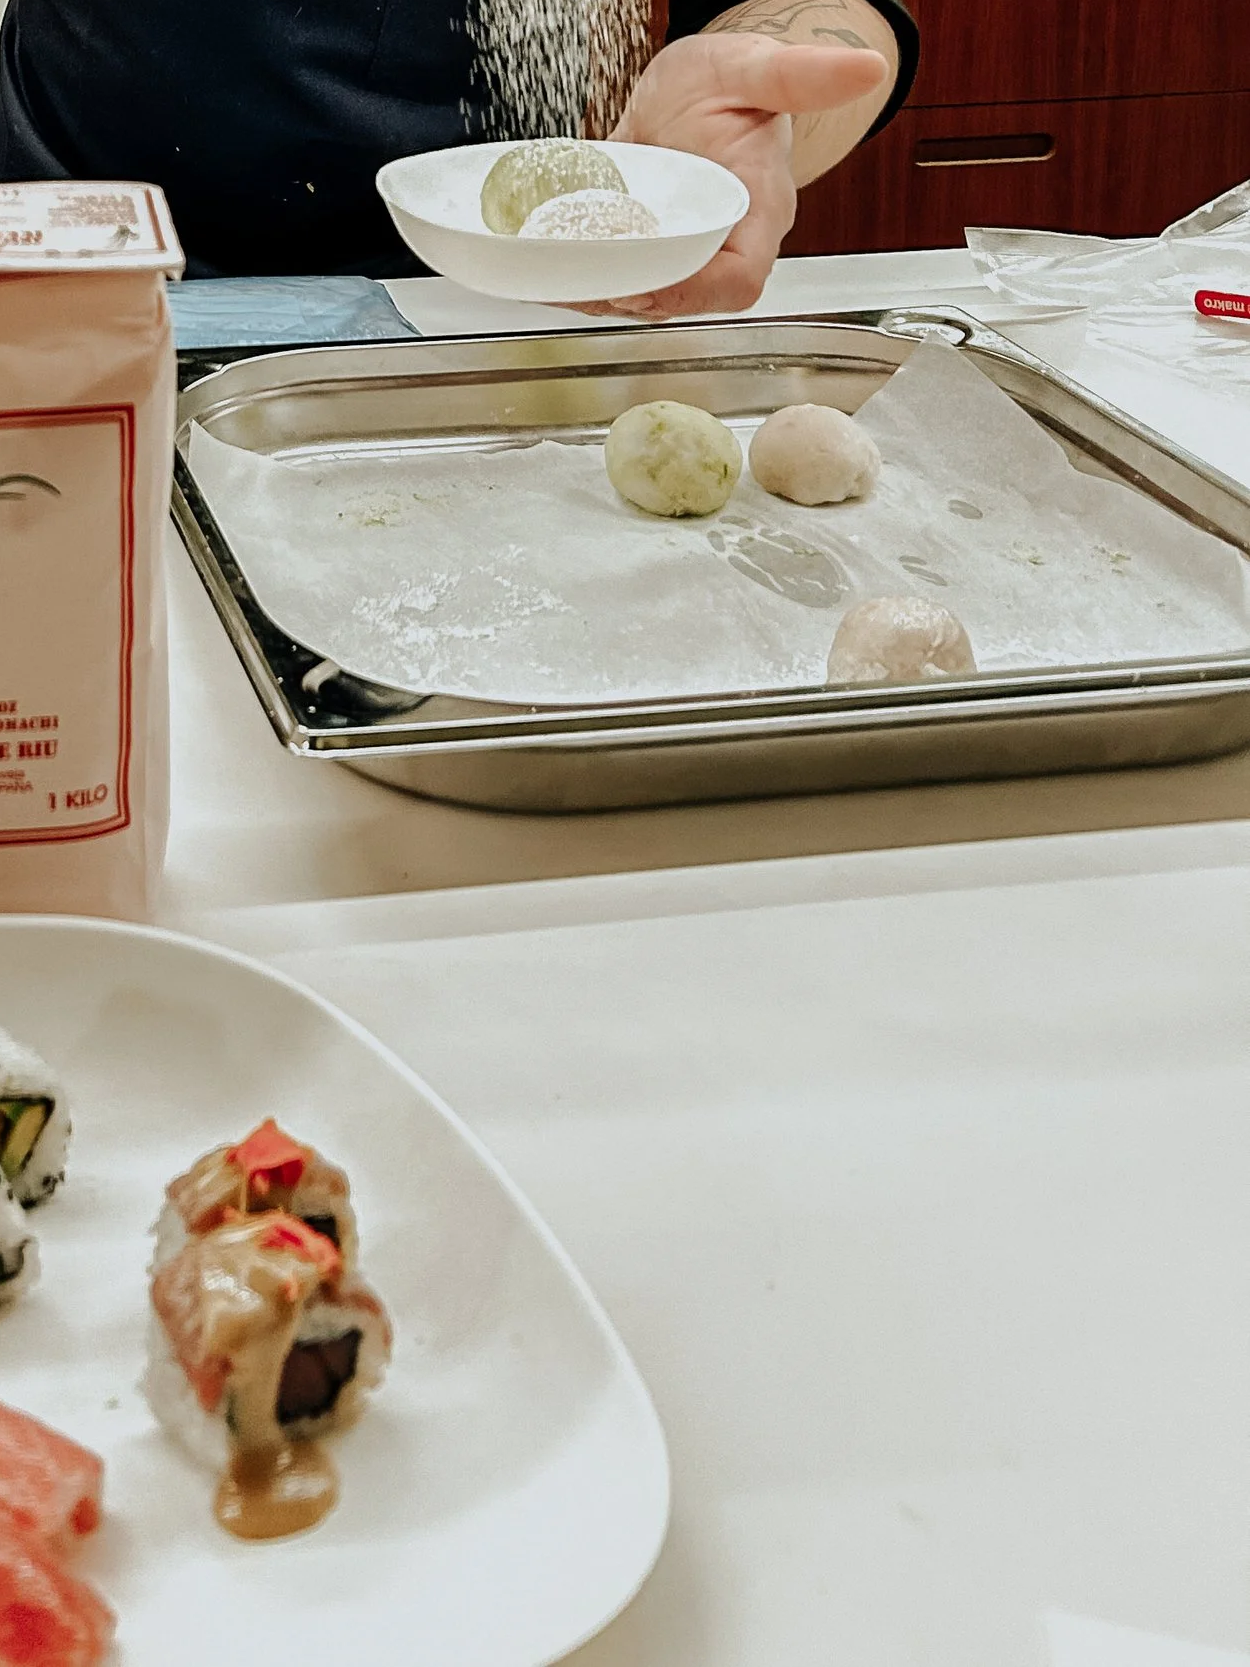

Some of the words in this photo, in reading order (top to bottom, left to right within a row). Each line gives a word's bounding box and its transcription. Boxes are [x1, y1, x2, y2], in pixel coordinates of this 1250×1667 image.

[1203, 298, 1245, 312] makro
[17, 739, 59, 759] RIU
[46, 792, 58, 813] 1
[64, 783, 108, 811] KILO
